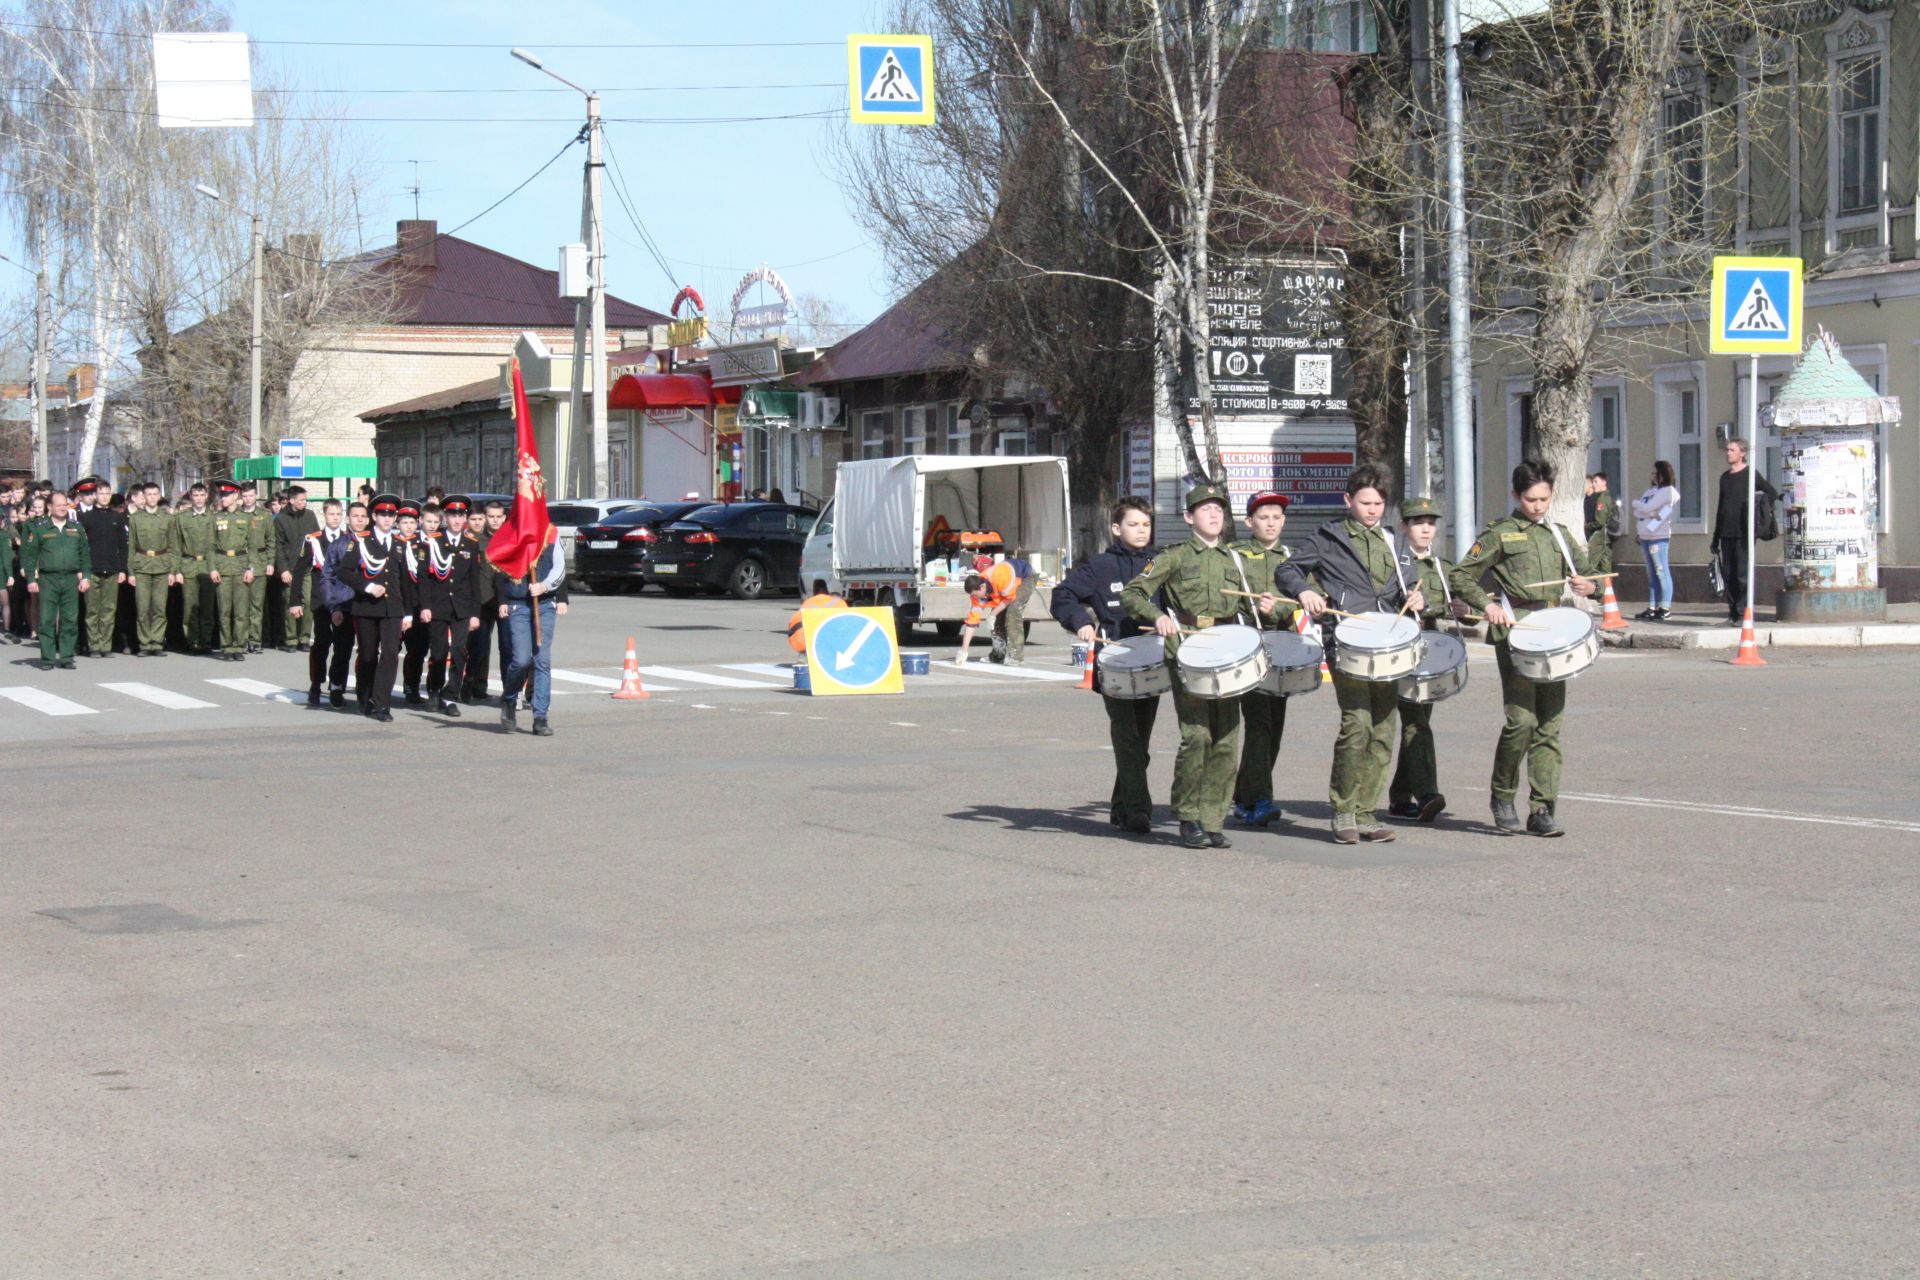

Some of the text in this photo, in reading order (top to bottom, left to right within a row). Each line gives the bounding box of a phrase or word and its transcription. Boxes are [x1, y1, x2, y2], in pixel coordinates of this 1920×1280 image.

[1208, 303, 1262, 319] люда
[1252, 337, 1311, 349] СПОРТИВНЫХ
[1222, 398, 1266, 409] СТОЛИКОВ
[1223, 453, 1302, 464] КСЕРОКОПИЯ
[1258, 467, 1274, 477] НА
[1279, 467, 1350, 477] ДОКУМЕНТЫ
